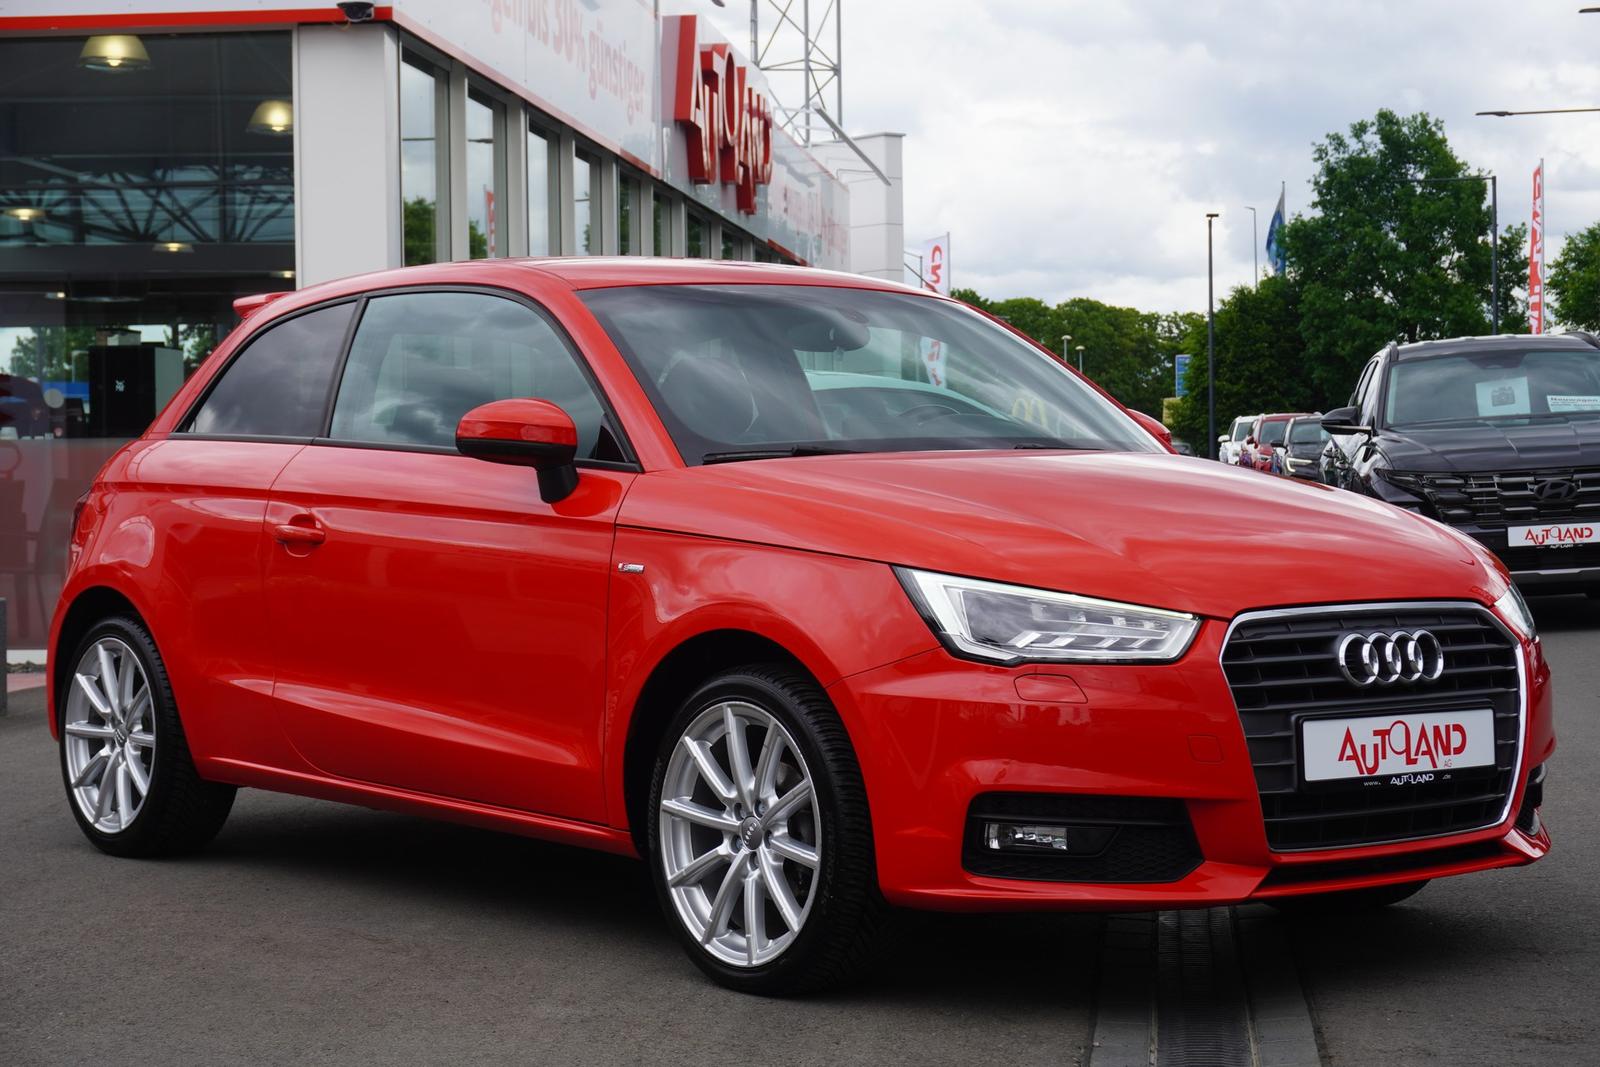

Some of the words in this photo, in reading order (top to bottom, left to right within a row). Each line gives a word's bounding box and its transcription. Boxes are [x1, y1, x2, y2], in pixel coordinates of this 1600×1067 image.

[1525, 526, 1593, 545] AUTOLAND
[1338, 719, 1467, 775] AUTOLAND
[1390, 773, 1435, 786] AUTOLAND
